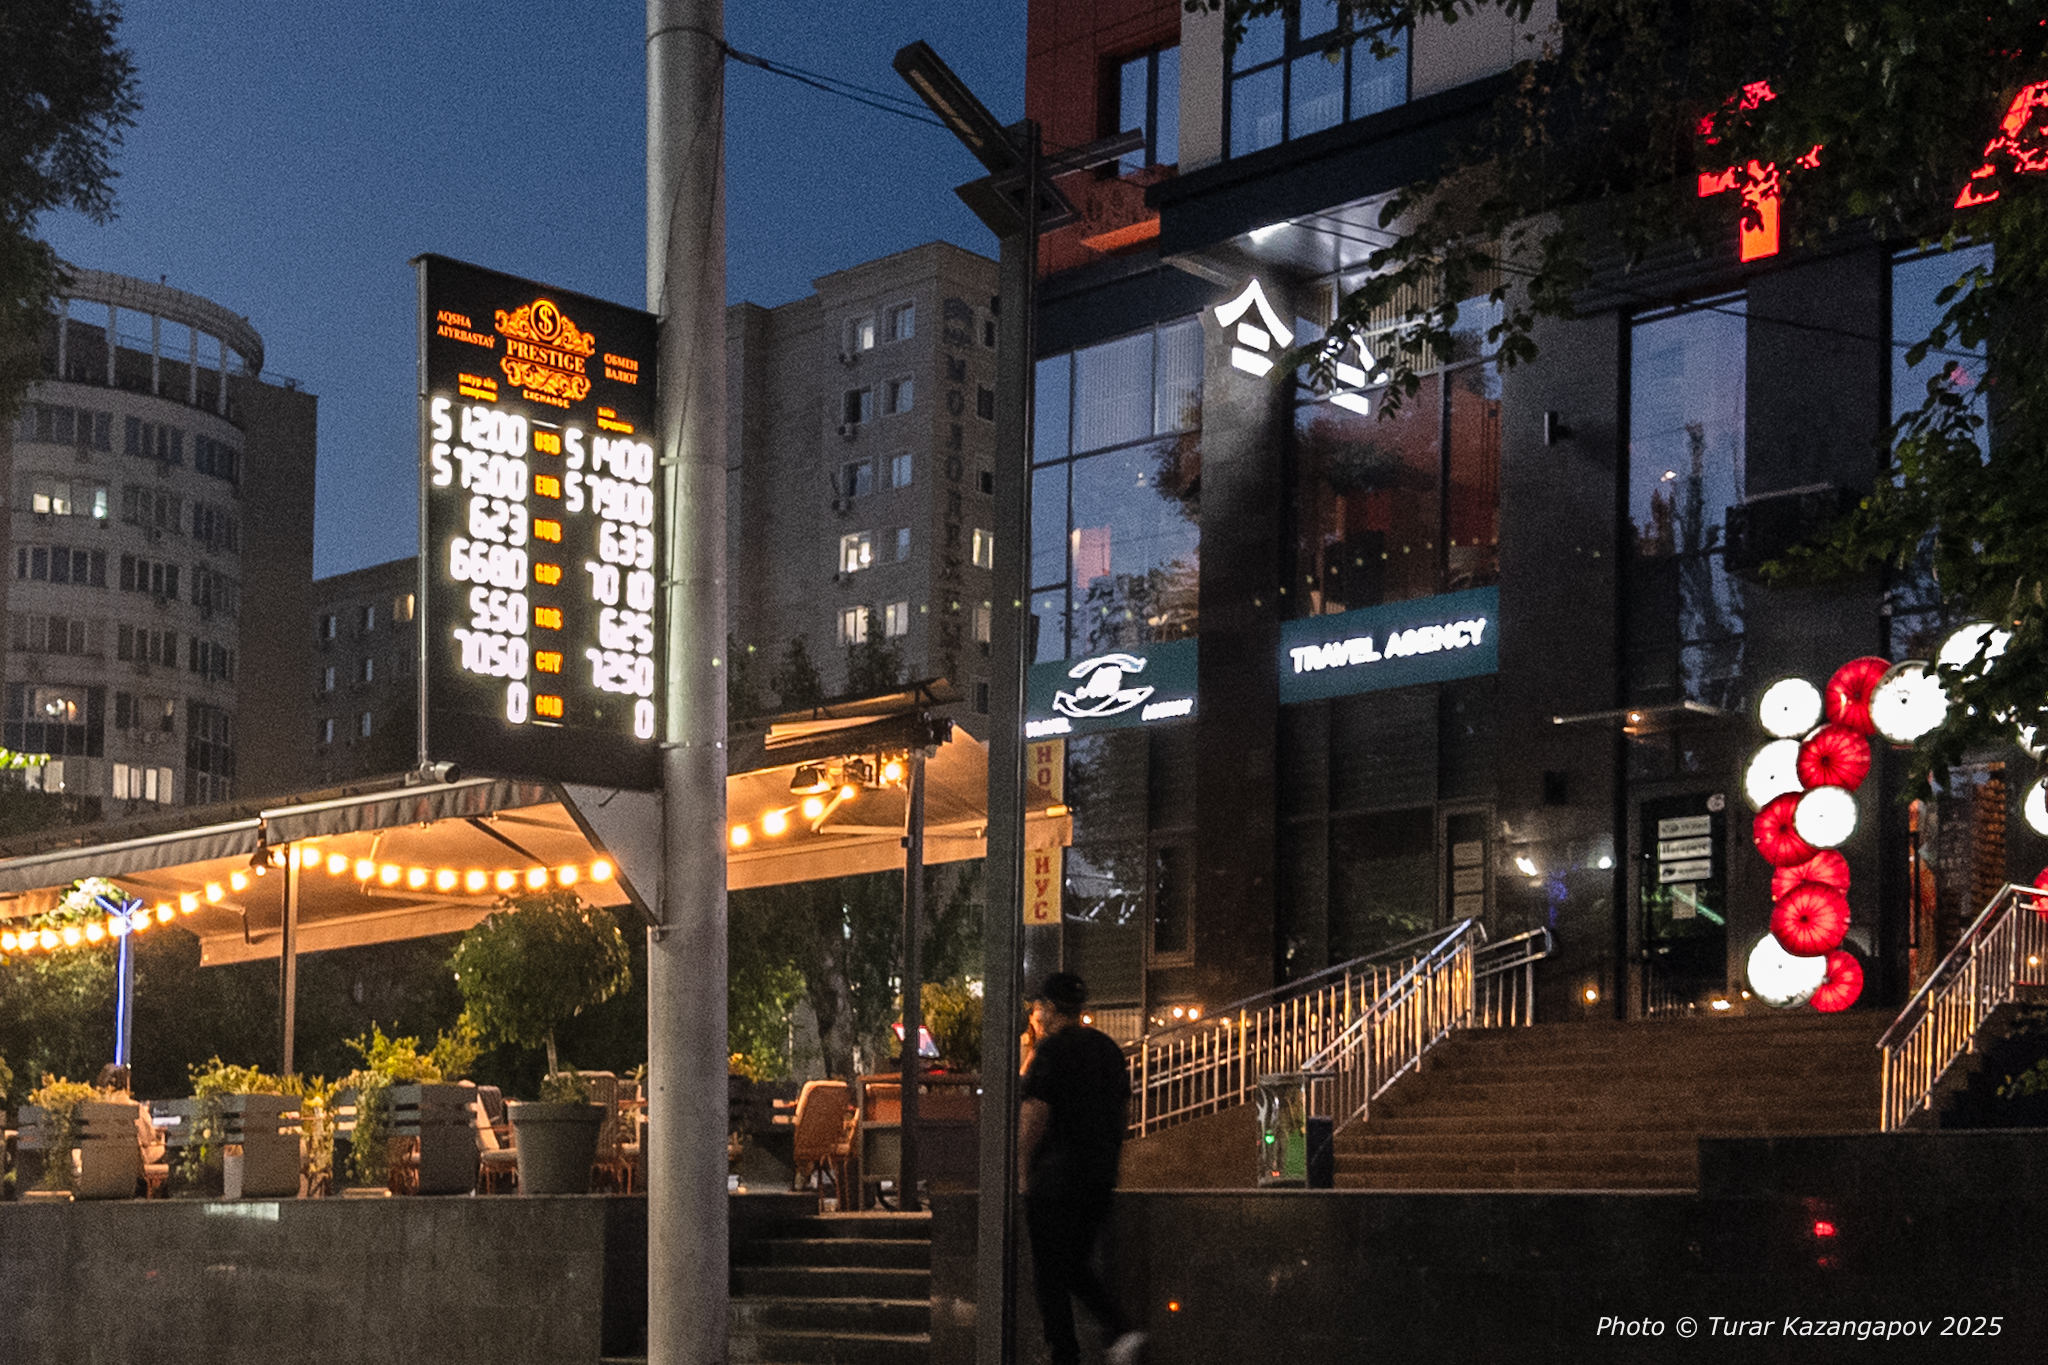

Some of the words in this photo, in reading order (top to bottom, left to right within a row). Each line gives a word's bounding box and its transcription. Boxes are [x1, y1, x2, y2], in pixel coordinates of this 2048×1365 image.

[437, 310, 471, 328] AQSHA
[506, 339, 586, 373] PRESTIGE
[604, 353, 638, 371] ОБМЕН
[605, 366, 638, 385] ВАЛЮТ
[523, 389, 570, 409] EXCHANGE
[534, 431, 561, 455] USD
[535, 475, 561, 499] EUR
[534, 519, 562, 543] RUB
[534, 562, 563, 586] GBP
[1289, 636, 1382, 674] TRAVEL
[1384, 617, 1487, 659] AGENCY
[535, 651, 563, 674] CNY
[506, 681, 529, 724] 0
[535, 695, 564, 718] GOLD
[634, 699, 654, 739] 0
